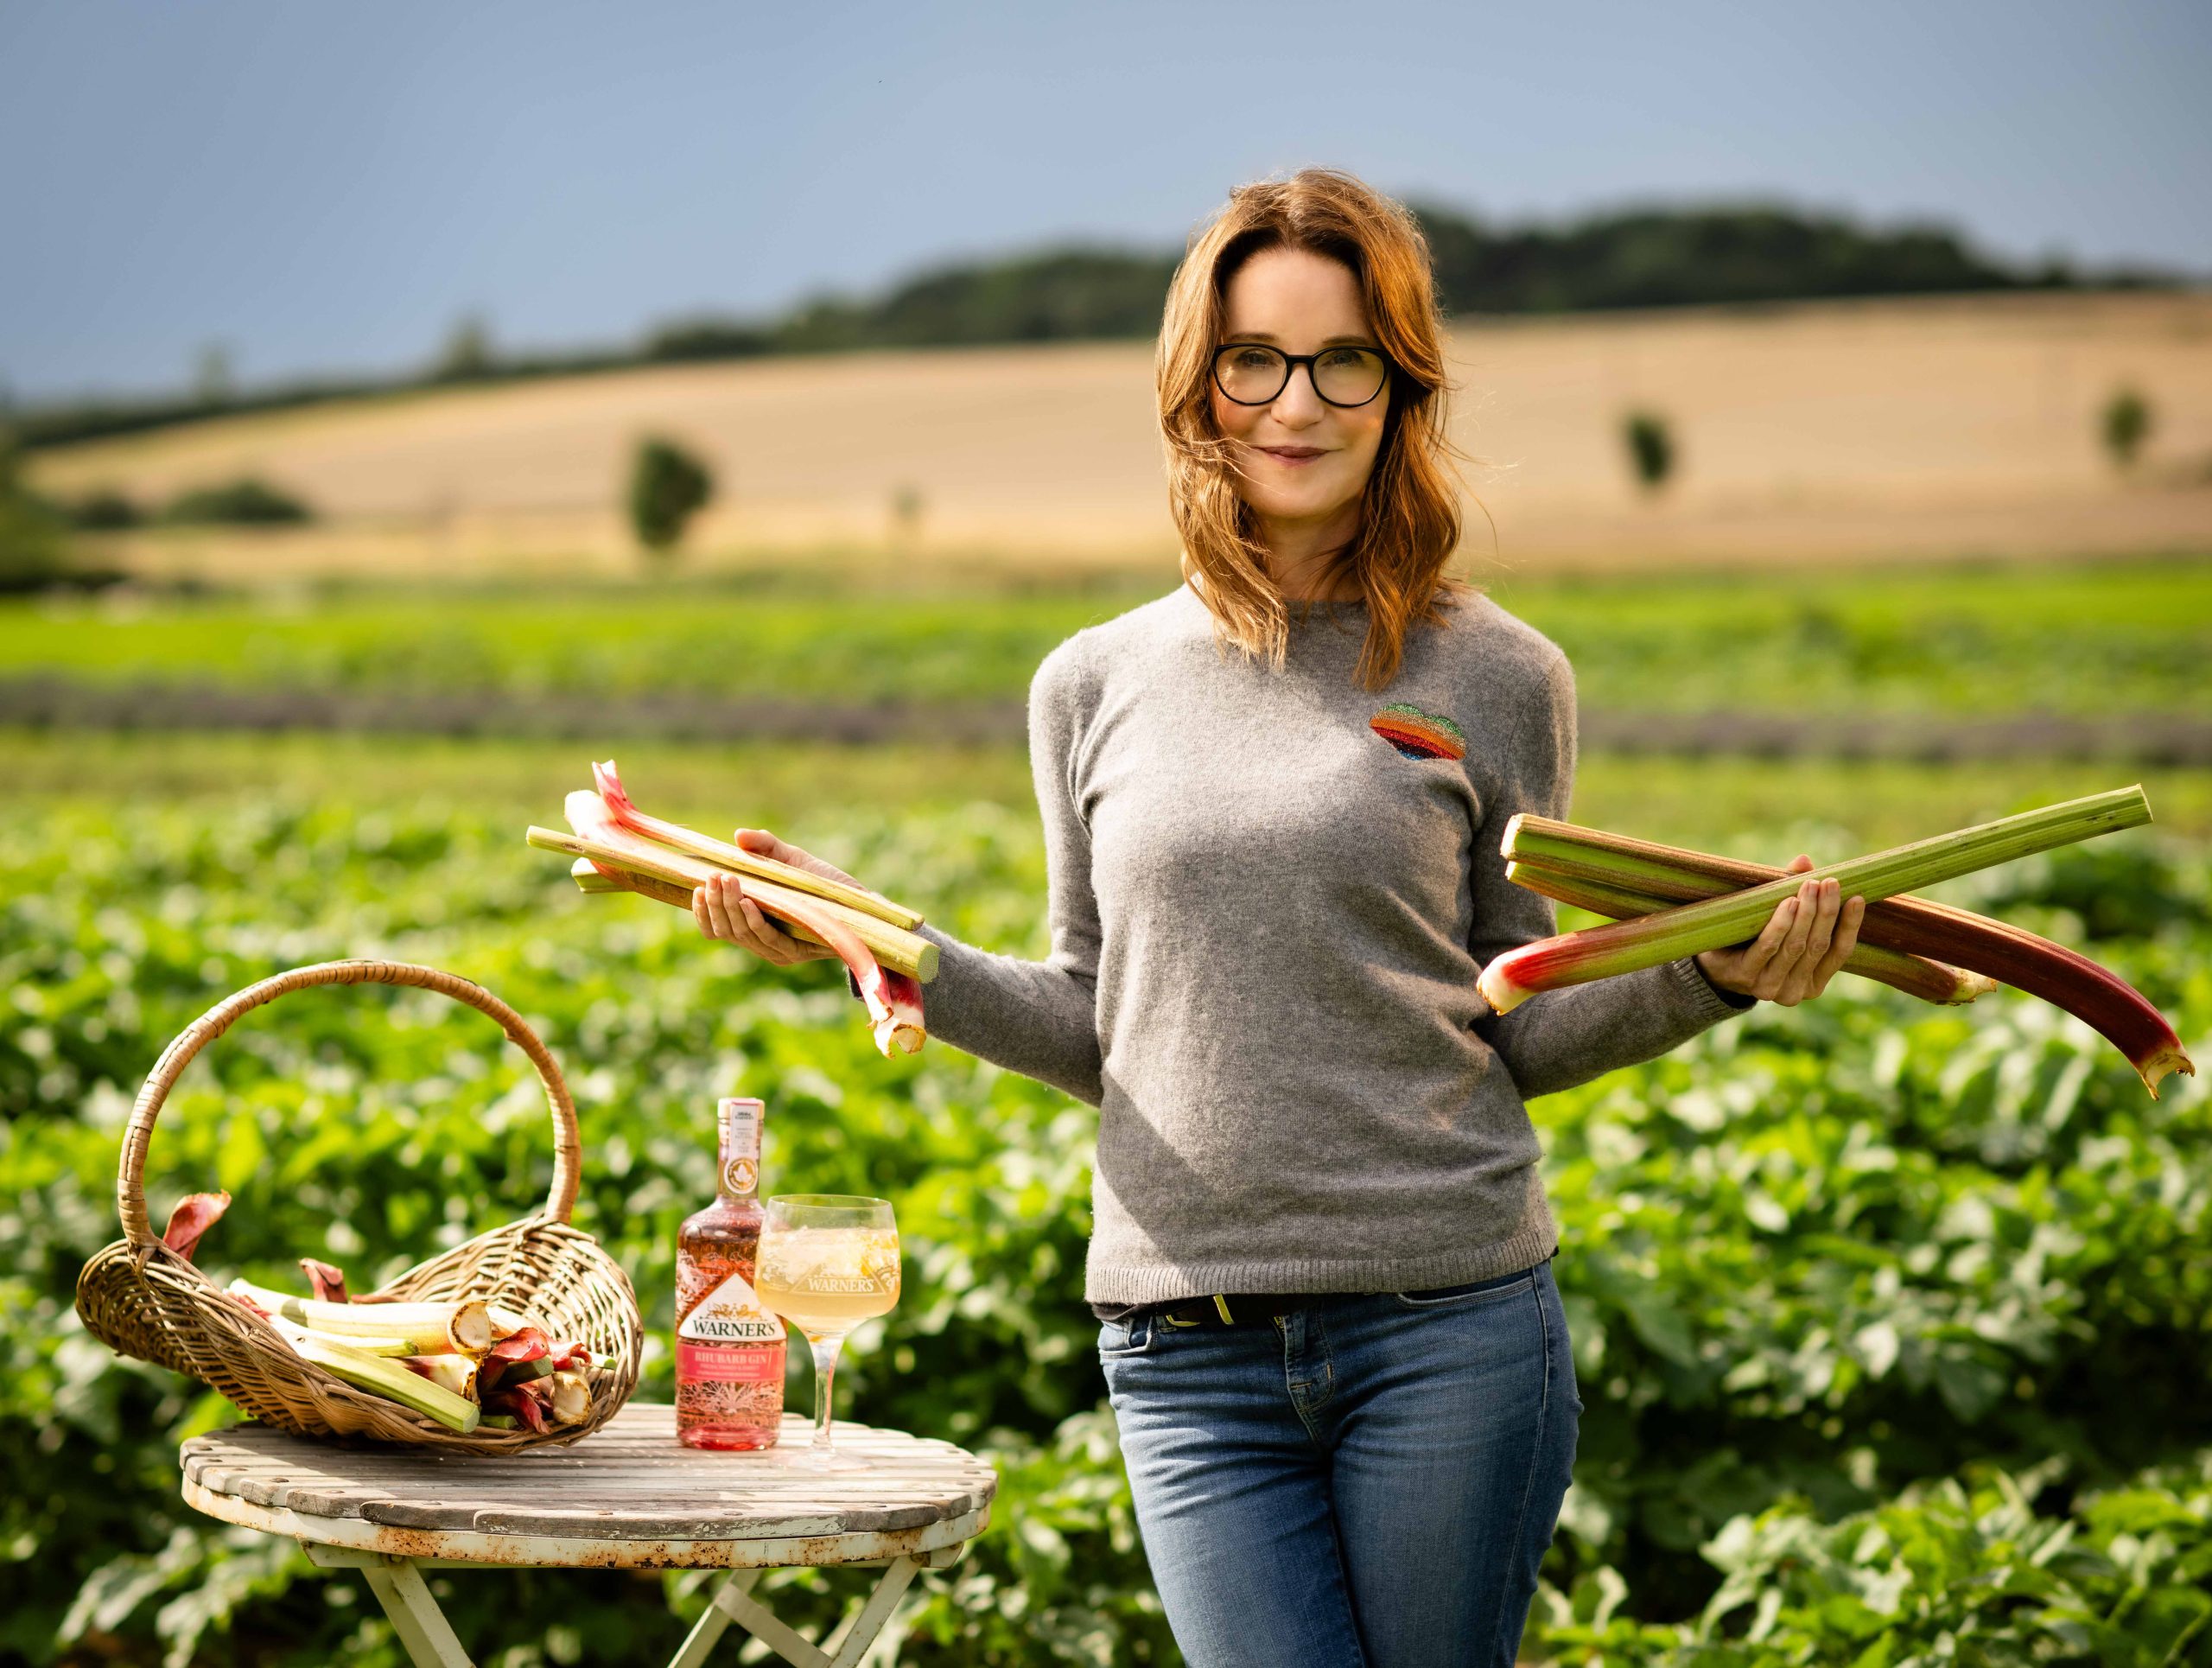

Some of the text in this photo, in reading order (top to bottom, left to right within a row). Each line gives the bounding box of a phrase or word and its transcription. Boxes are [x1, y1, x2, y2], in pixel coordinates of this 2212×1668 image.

[808, 1278, 874, 1293] WARNER'S
[693, 1320, 776, 1337] WARNER'S
[695, 1351, 767, 1364] RHUBARB GIN
